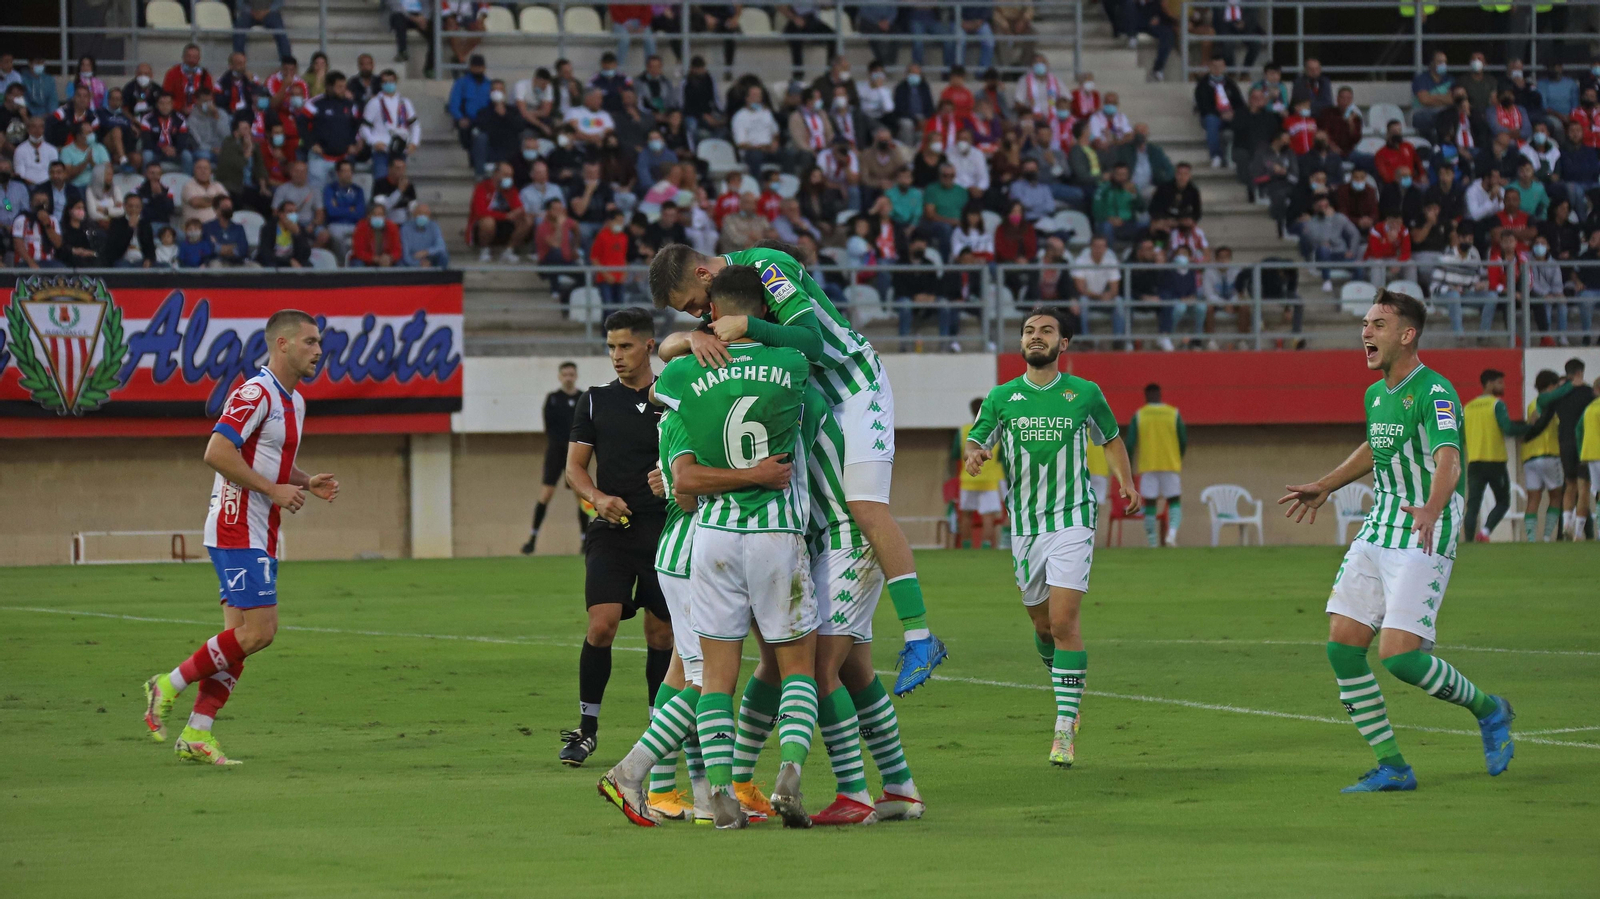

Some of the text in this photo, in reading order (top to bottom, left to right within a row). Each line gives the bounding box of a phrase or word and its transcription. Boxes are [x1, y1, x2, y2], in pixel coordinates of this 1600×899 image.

[691, 366, 791, 397] MARCHENA
[723, 396, 769, 470] 6
[1011, 416, 1073, 430] FOREVER
[1020, 429, 1063, 442] GREEN
[1370, 437, 1394, 449] GREEN
[257, 557, 271, 584] 7
